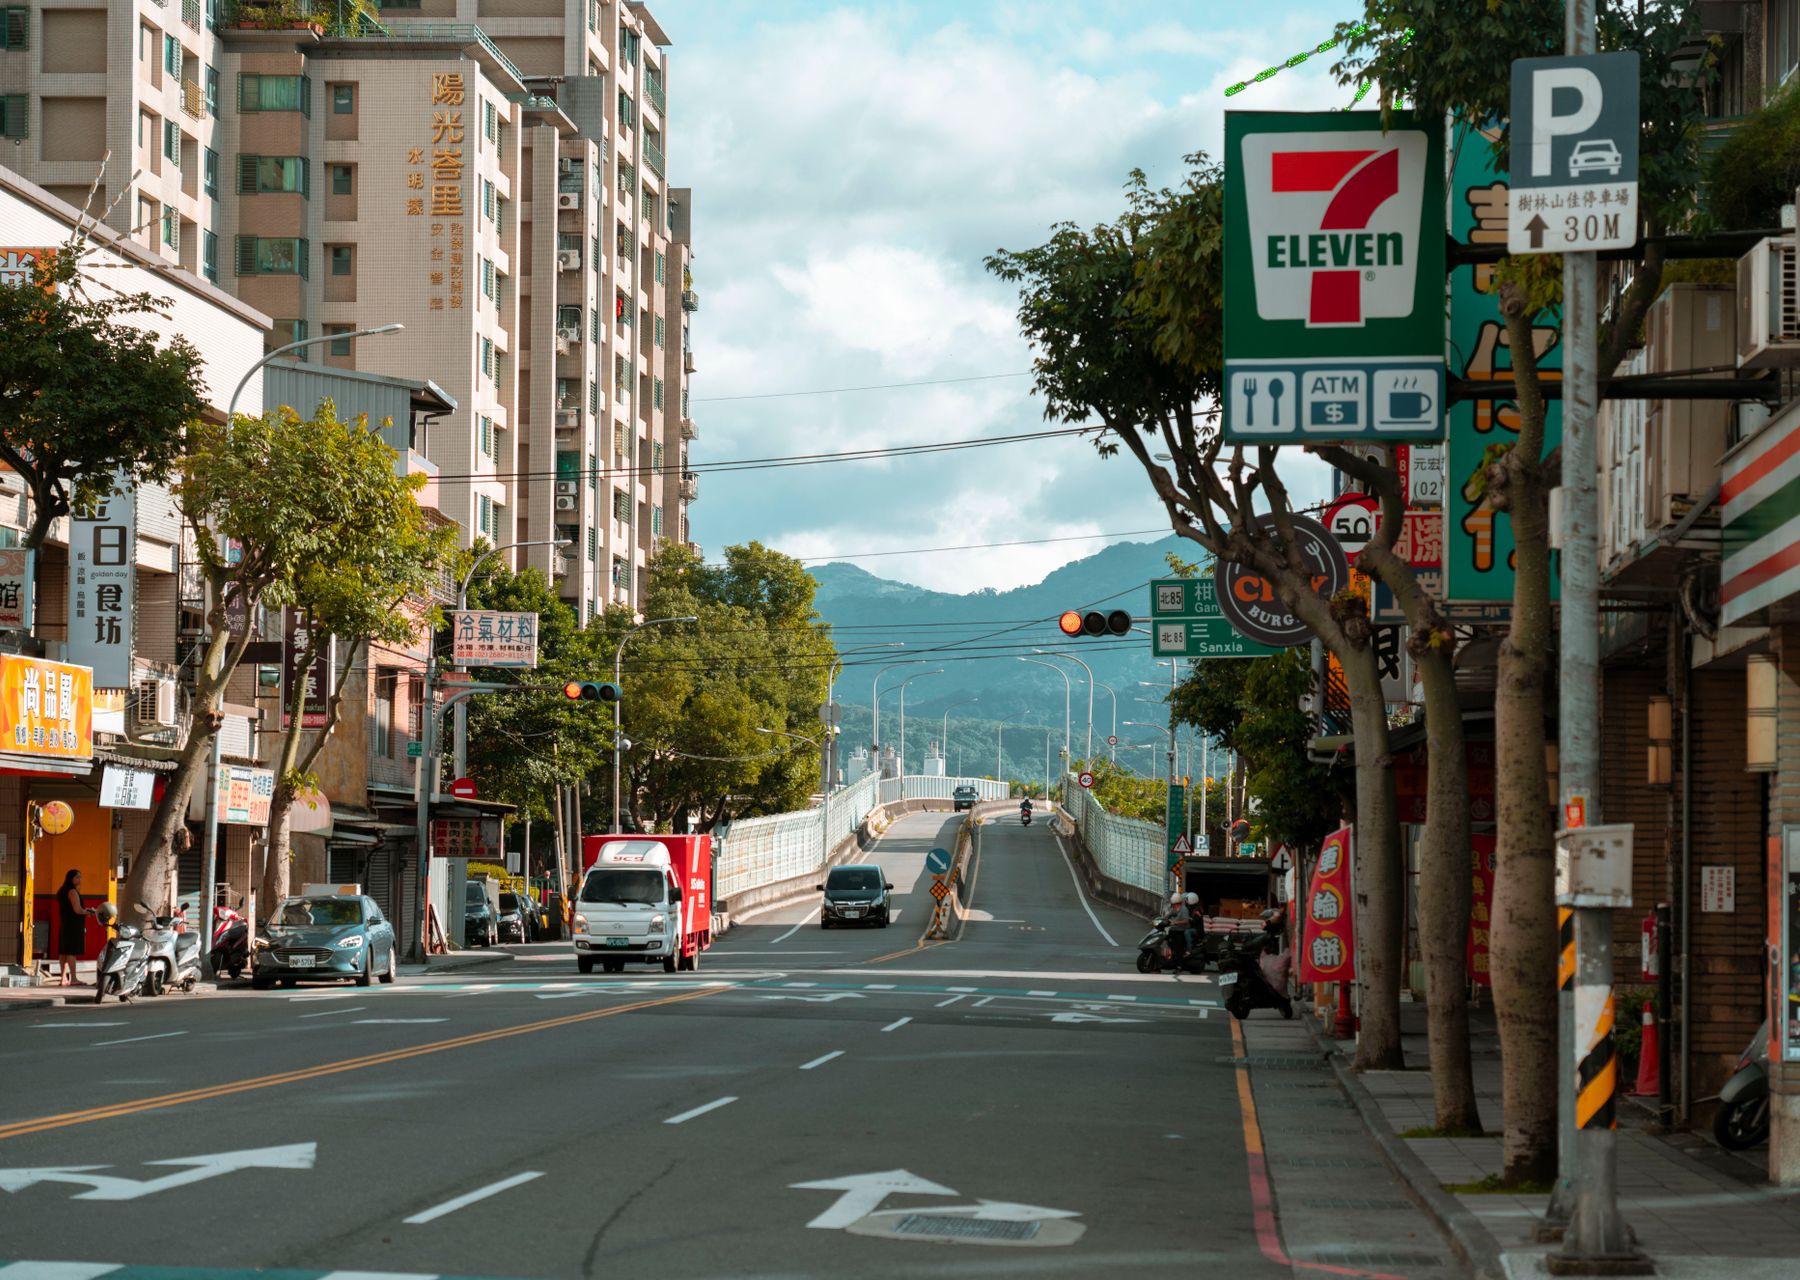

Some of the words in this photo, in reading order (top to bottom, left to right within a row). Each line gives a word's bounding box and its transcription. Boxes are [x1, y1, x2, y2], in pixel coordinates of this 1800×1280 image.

[1531, 67, 1604, 178] P
[1517, 187, 1632, 212] 樹林山佳停車場
[1271, 147, 1400, 323] 7
[1564, 213, 1621, 243] 30M
[1311, 376, 1360, 395] ATM
[1336, 517, 1370, 535] 50
[458, 614, 533, 644] 冷氣材料
[1199, 641, 1243, 653] Sanxia
[1196, 835, 1206, 849] P
[1312, 846, 1341, 967] 車輪餅
